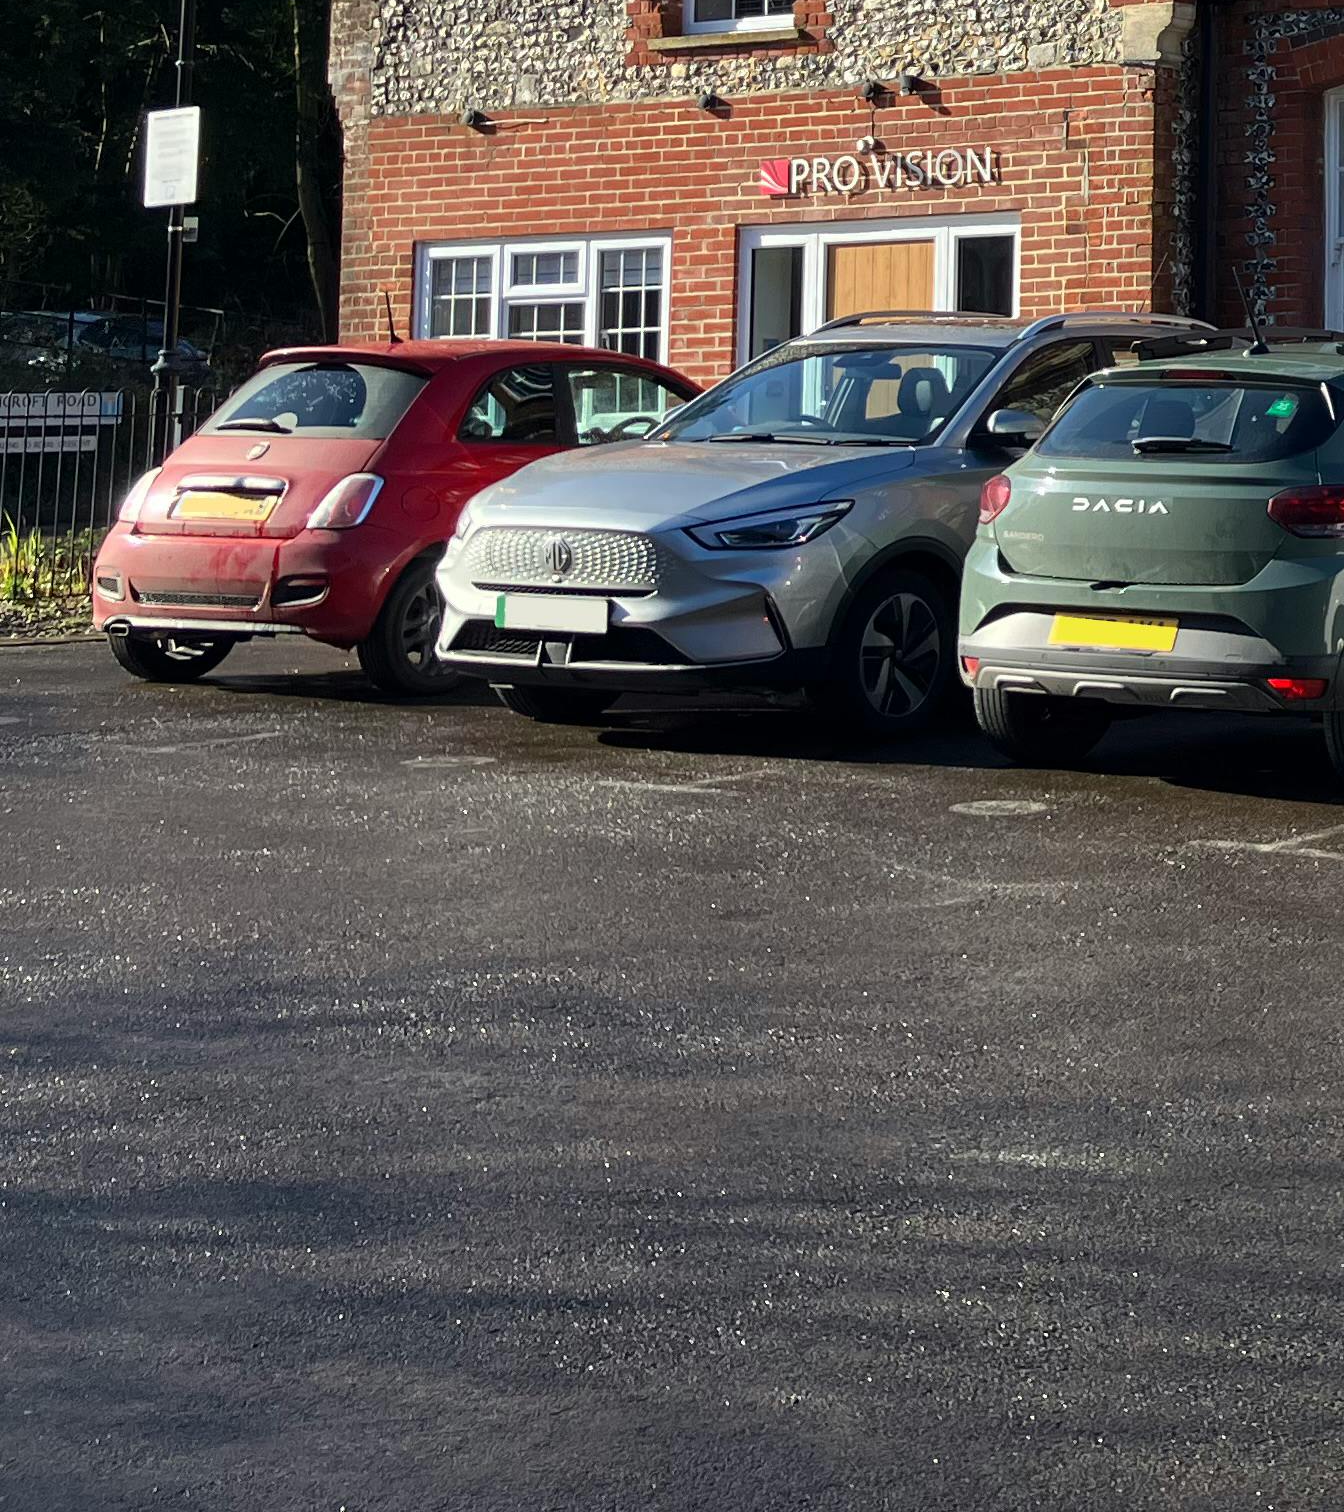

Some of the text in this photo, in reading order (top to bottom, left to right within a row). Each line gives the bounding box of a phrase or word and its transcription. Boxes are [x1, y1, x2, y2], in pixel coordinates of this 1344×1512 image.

[791, 147, 992, 194] PRO VISION
[0, 395, 46, 408] CROFT
[1072, 497, 1169, 515] DACIA
